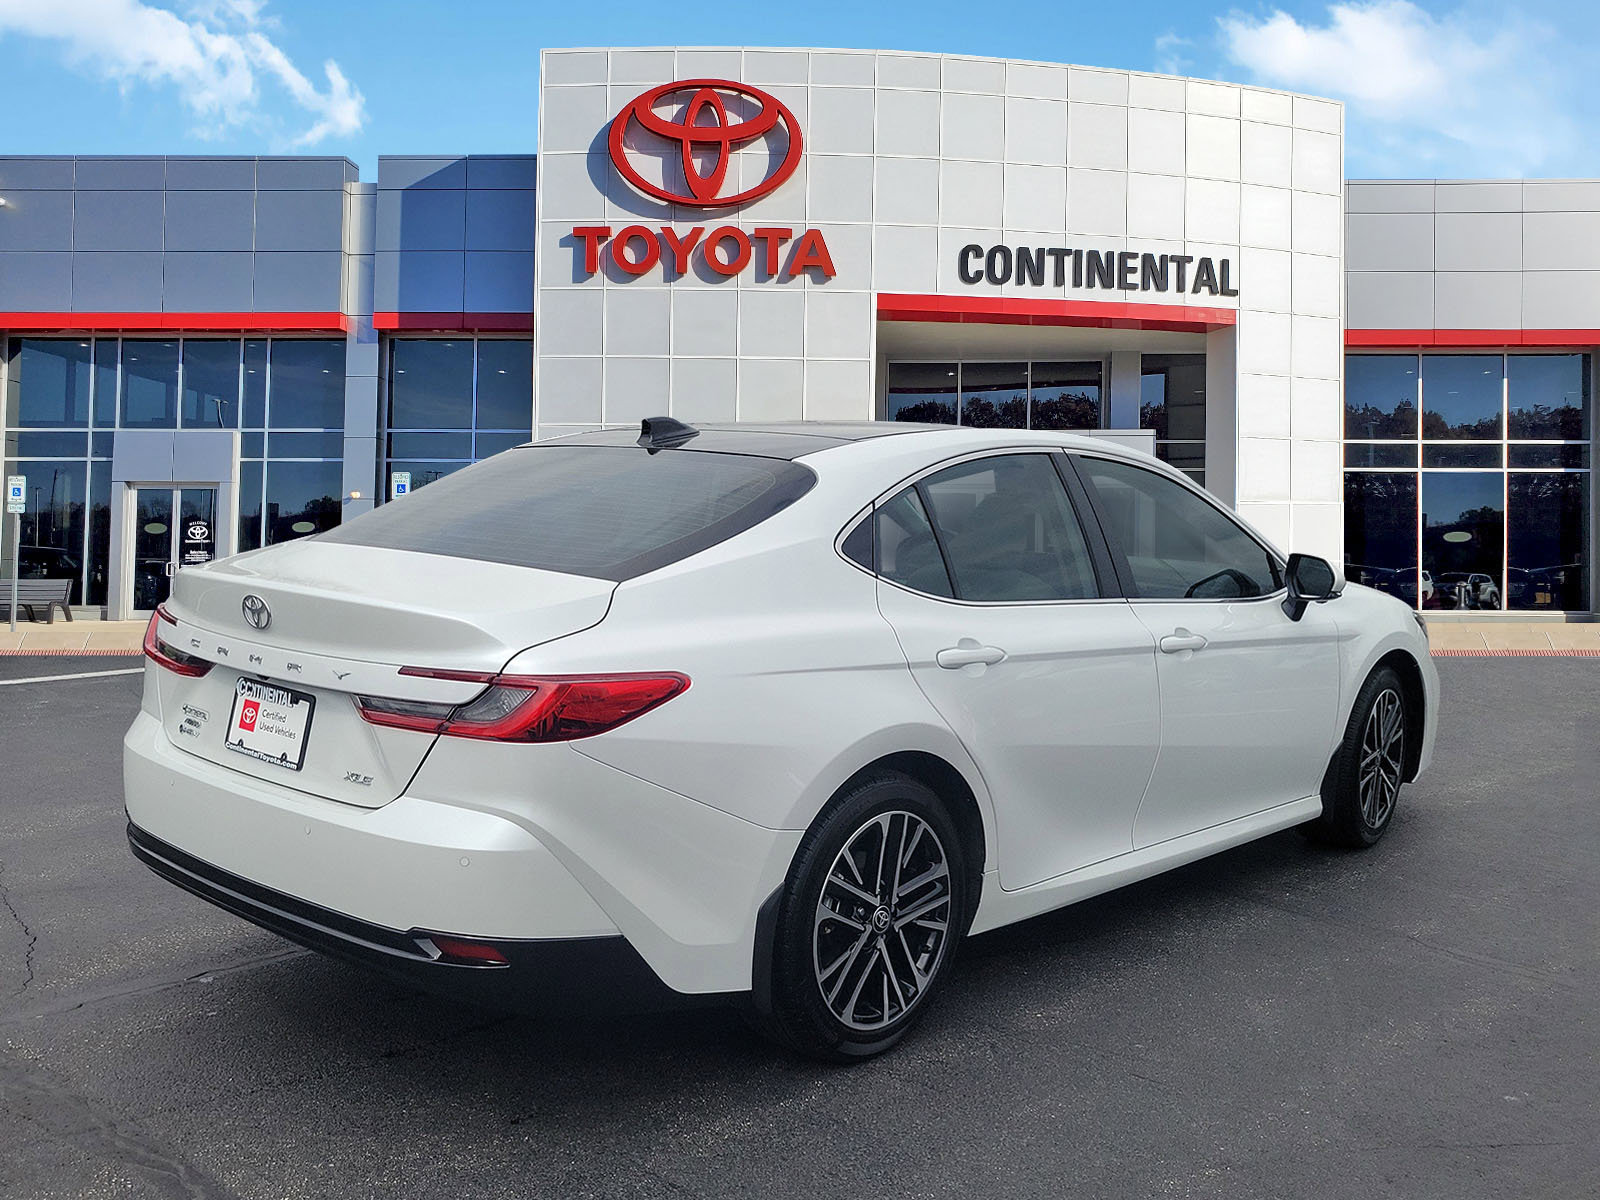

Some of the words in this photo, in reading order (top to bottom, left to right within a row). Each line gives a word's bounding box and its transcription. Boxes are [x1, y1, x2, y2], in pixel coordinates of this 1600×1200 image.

[573, 225, 836, 275] TOYOTA
[958, 244, 1238, 297] CONTINENTAL
[190, 638, 351, 681] CAMRY
[259, 722, 273, 734] Used
[274, 726, 296, 739] Vehicles
[261, 709, 287, 723] Certified
[225, 741, 297, 770] ContinentalToyota.com
